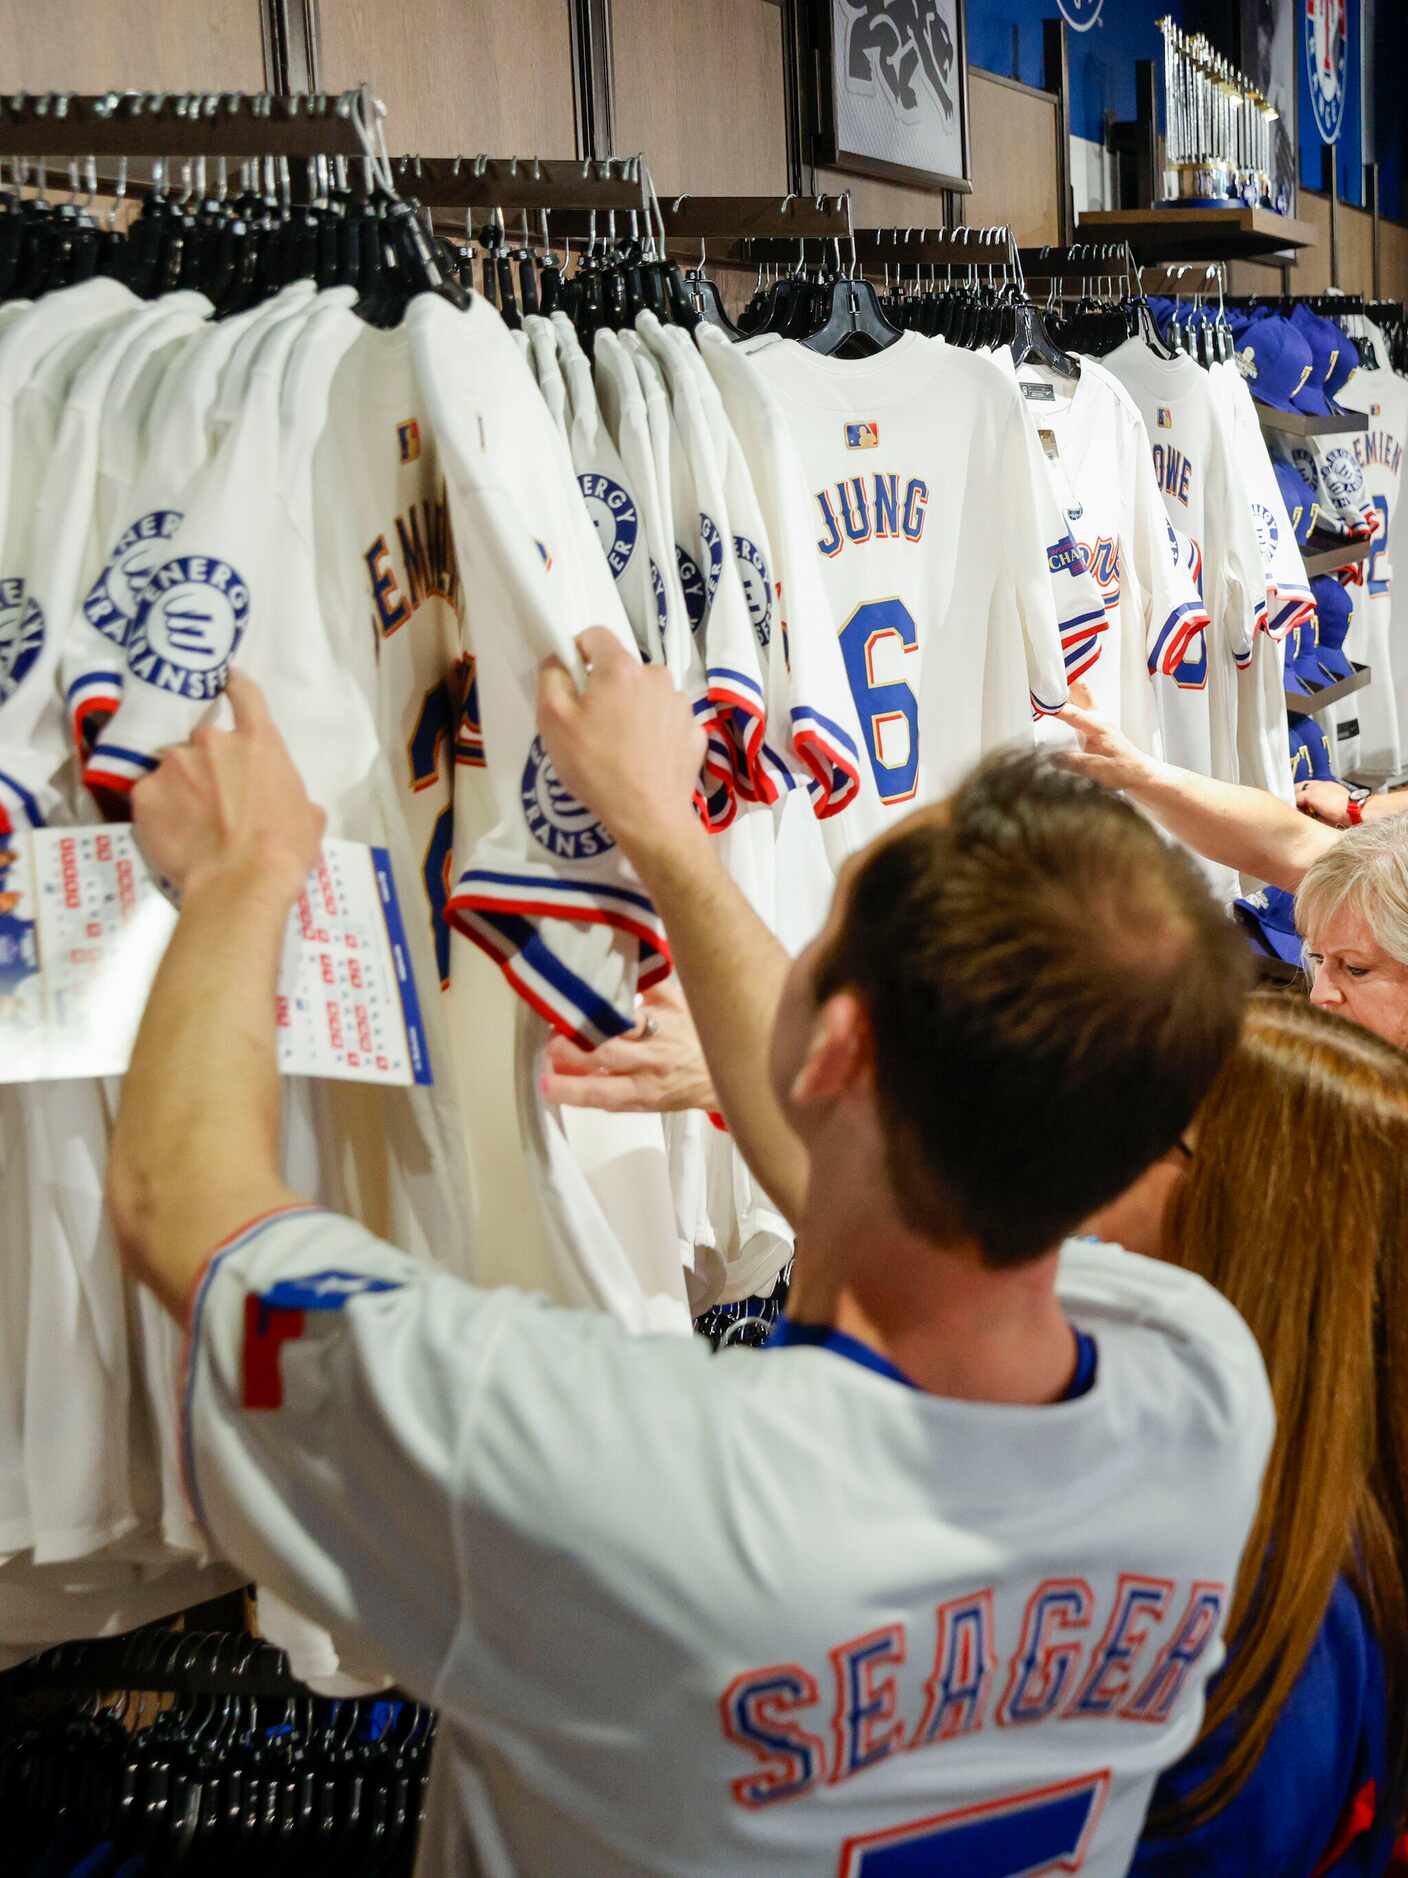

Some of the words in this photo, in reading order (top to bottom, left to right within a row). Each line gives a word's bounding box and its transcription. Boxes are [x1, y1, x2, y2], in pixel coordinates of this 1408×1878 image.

[1152, 443, 1192, 508] OWE
[1352, 430, 1403, 478] EMIEN
[583, 475, 637, 523] ERGY
[815, 472, 929, 558] JUNG
[837, 596, 919, 805] 6
[720, 1574, 1225, 1810] SEAGER
